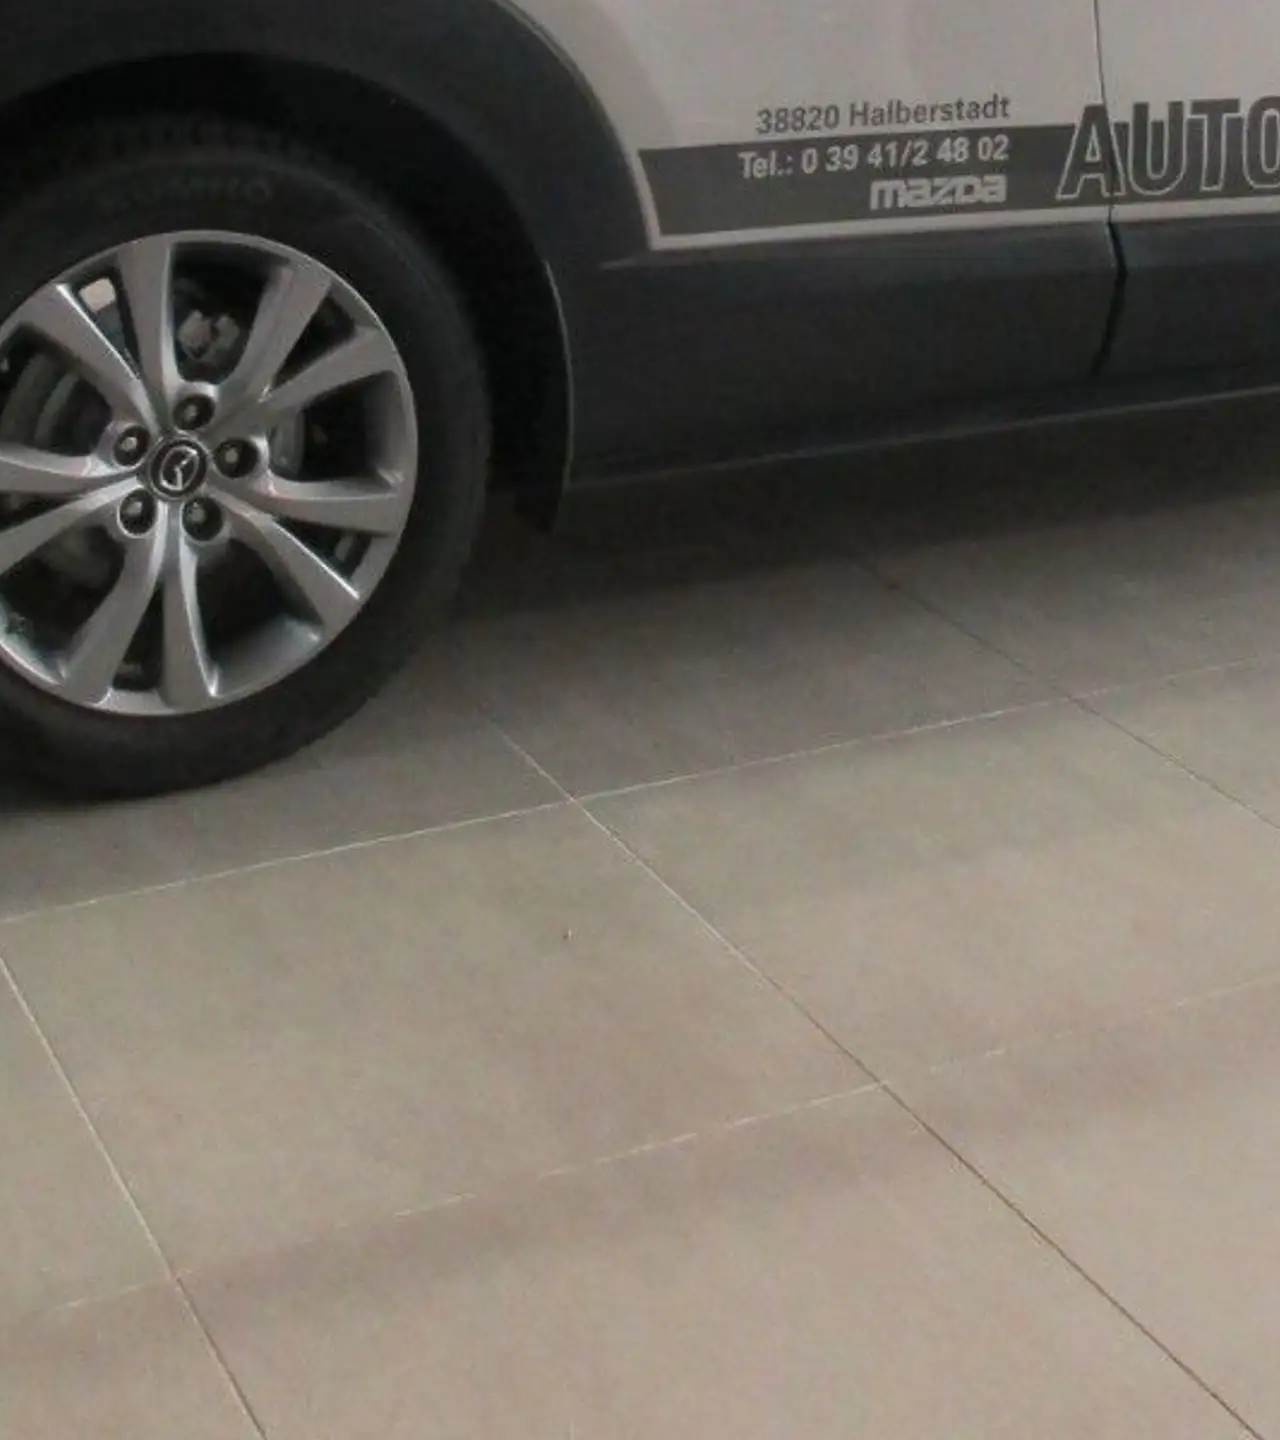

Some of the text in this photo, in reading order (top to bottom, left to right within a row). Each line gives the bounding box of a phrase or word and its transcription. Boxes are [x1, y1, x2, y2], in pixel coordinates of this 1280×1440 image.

[756, 94, 1011, 135] 38820 Halberstadt
[738, 133, 1010, 180] Tel.: 0 39 41/2 48 02
